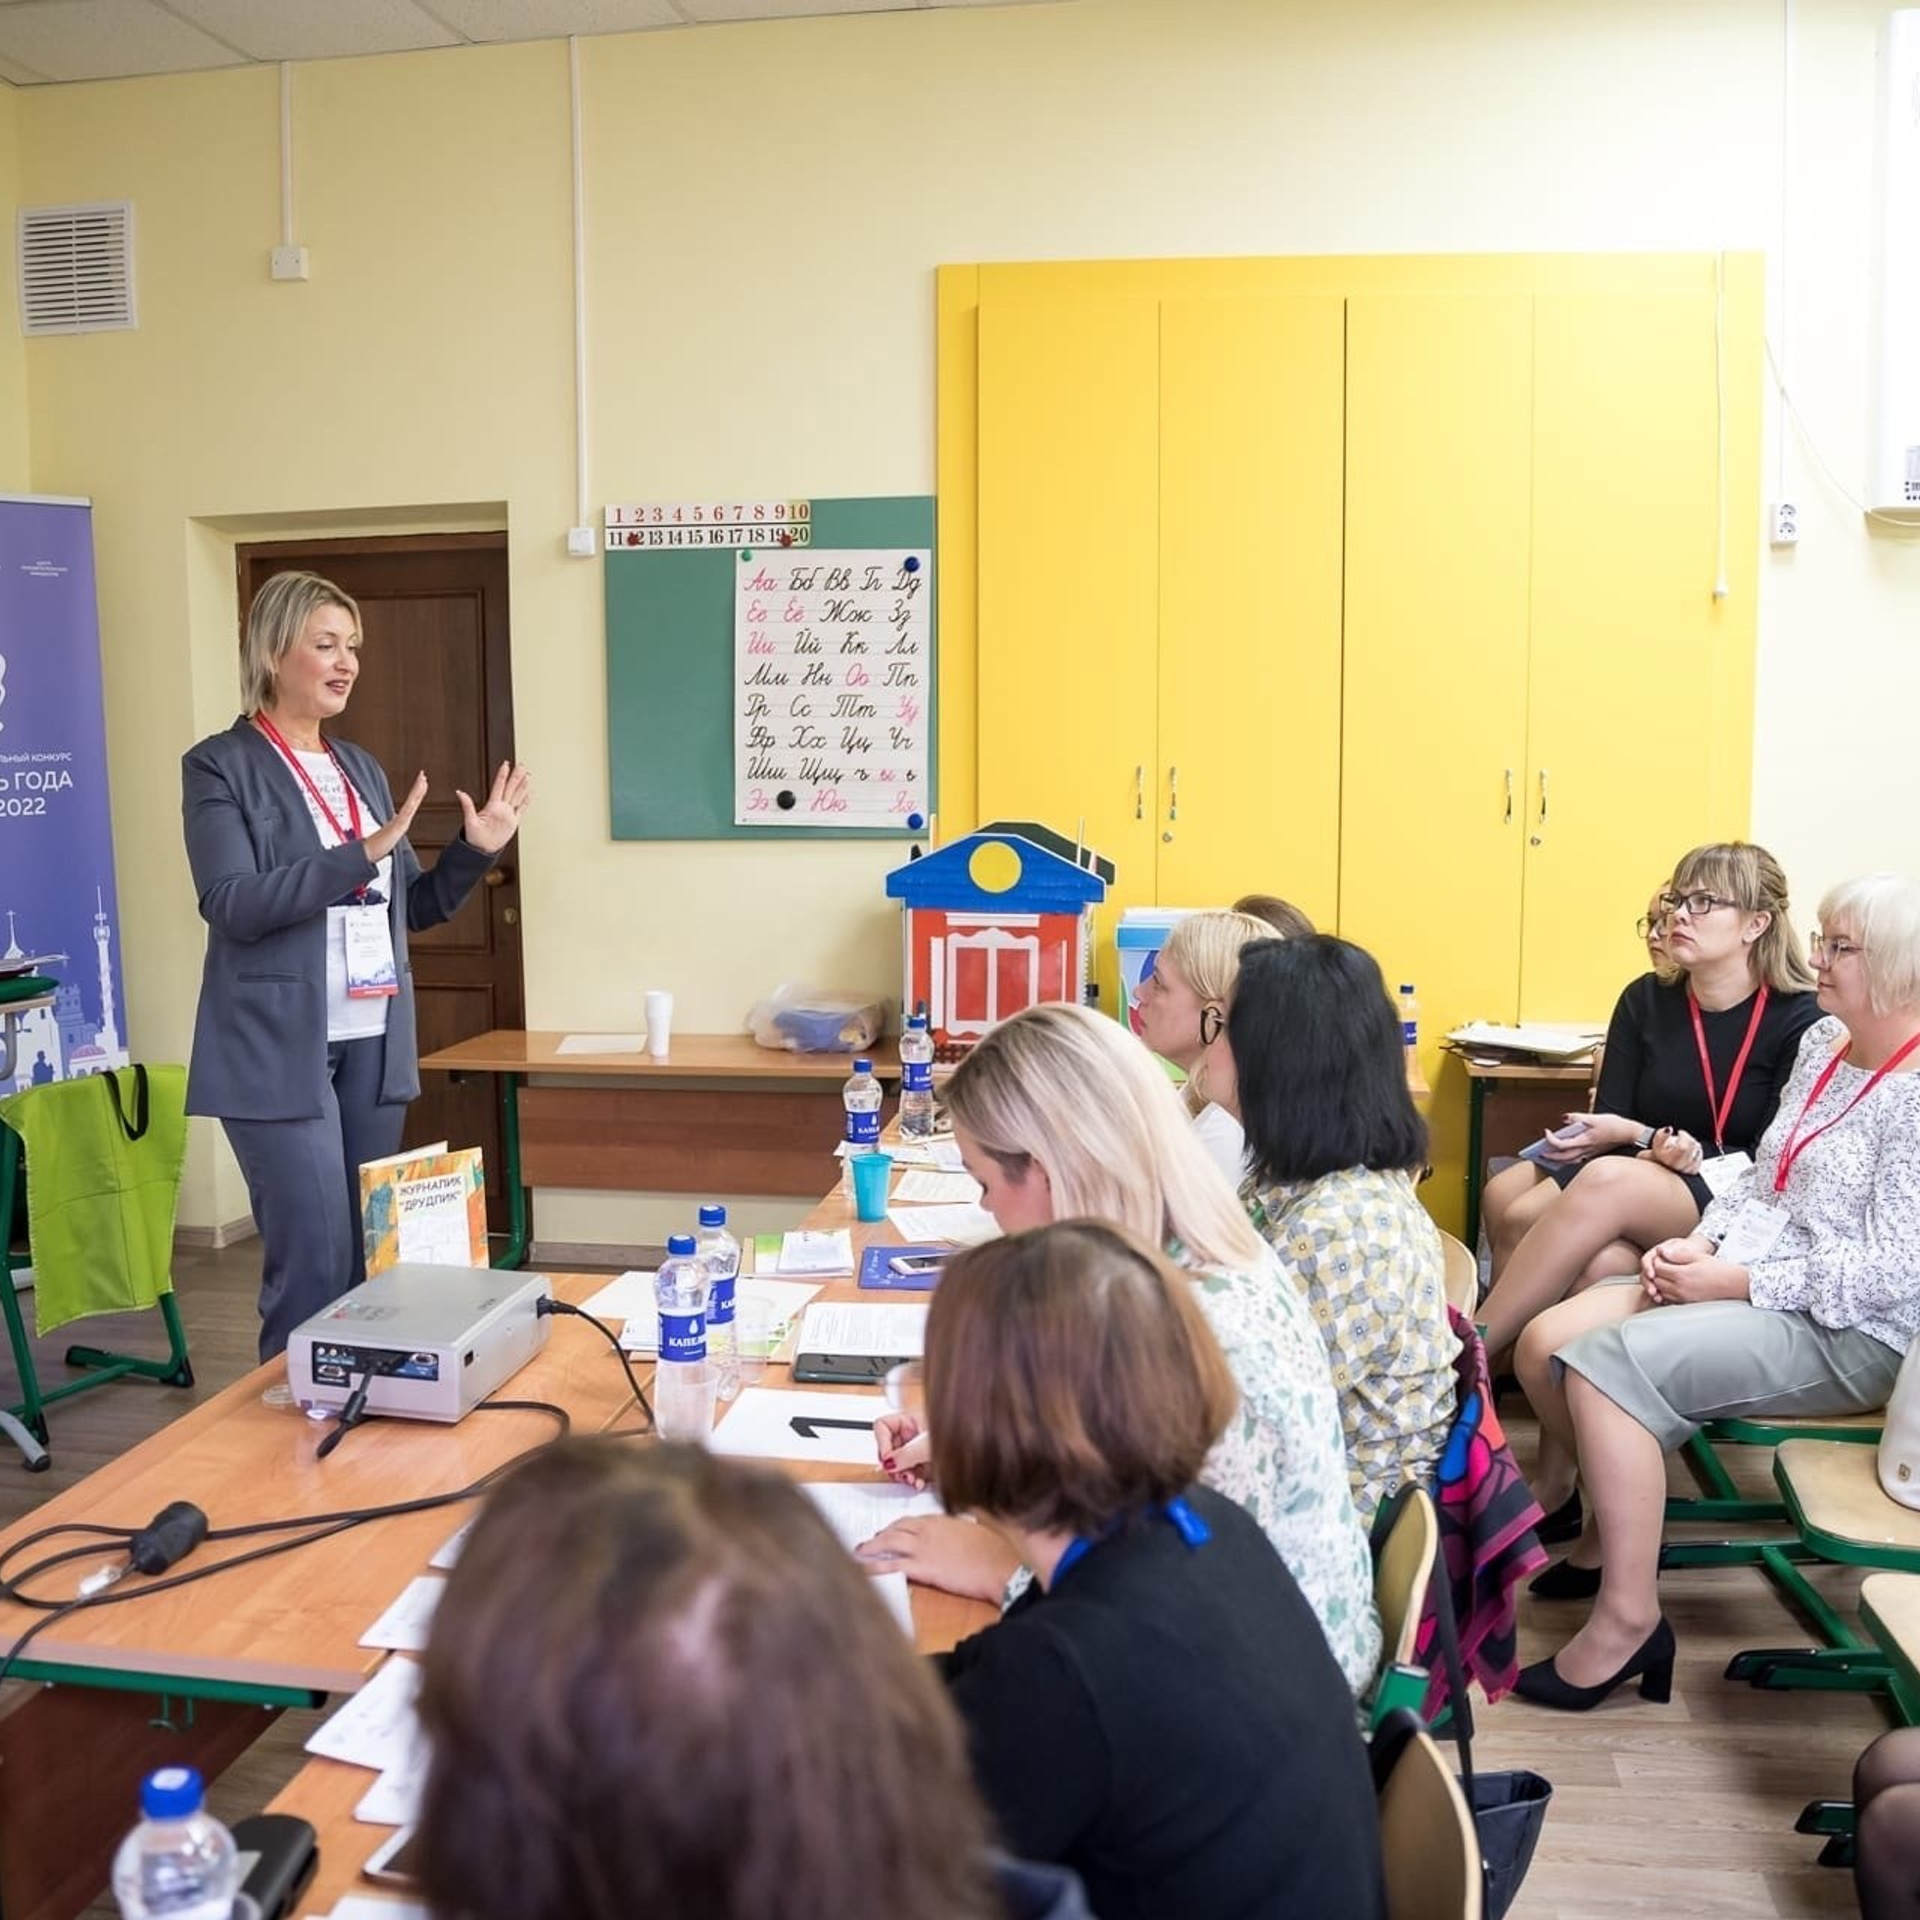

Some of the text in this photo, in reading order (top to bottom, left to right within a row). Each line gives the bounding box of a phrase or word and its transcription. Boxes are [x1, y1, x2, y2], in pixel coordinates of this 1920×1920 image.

[615, 504, 809, 522] 1 2 3 4 5 6 7 8 9 10
[610, 532, 623, 546] 11
[650, 531, 663, 545] 13
[669, 530, 682, 545] 14
[688, 530, 703, 544] 15
[708, 529, 724, 544] 16
[729, 529, 743, 544] 17
[750, 529, 765, 543] 18
[791, 528, 809, 543] 20
[744, 566, 922, 600] Аа Бб Вв Гг Дд
[819, 599, 873, 622] Жж
[888, 599, 912, 632] Зз
[747, 628, 919, 654] Ии Йй Кк Лл
[744, 662, 918, 686] Мм Нн Оо Пп
[744, 693, 919, 726] Рр Сс Тт Уу
[745, 725, 913, 756] Фф Хх Цц Чч
[31, 752, 72, 762] КОНКУРС
[15, 771, 73, 792] ГОДА
[747, 756, 917, 786] Шш Щщ ъ ы ь
[746, 788, 917, 814] Ээ Юю Яя
